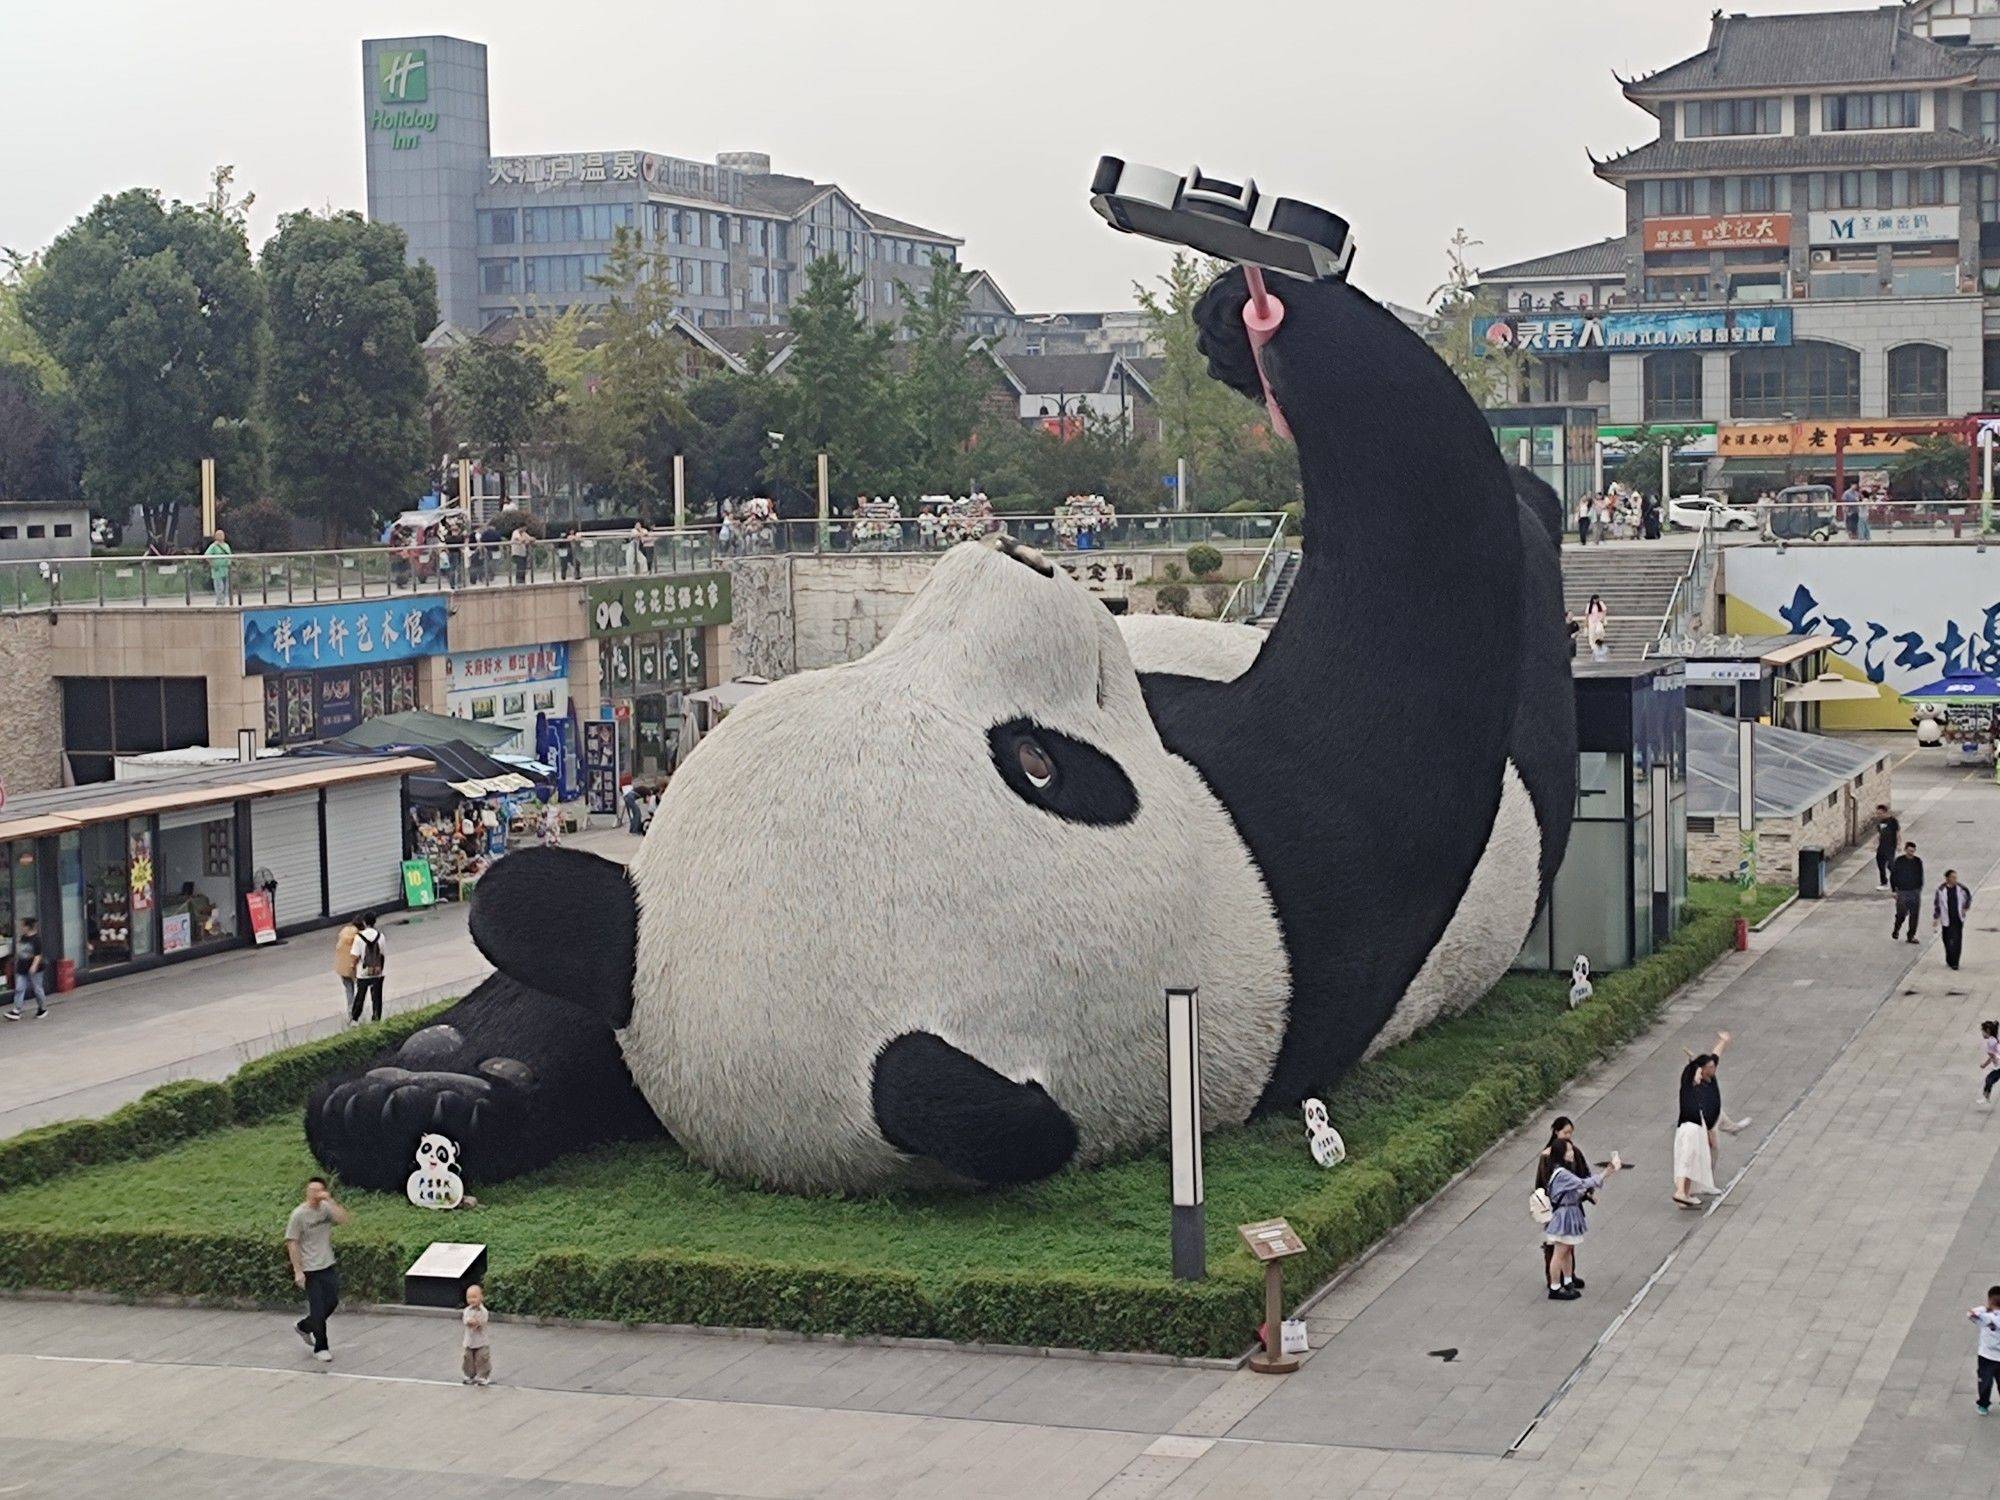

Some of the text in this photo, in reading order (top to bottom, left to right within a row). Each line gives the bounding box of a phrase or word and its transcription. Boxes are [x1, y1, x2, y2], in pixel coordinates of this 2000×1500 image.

[370, 109, 438, 133] Holiday
[391, 132, 422, 150] Inn
[489, 152, 638, 185] 大江户温泉
[1517, 319, 1605, 350] 灵异人
[1721, 433, 1790, 446] 老灌县砂锅
[273, 608, 424, 664] 祥叶轩艺术馆
[464, 657, 503, 677] 天府好水
